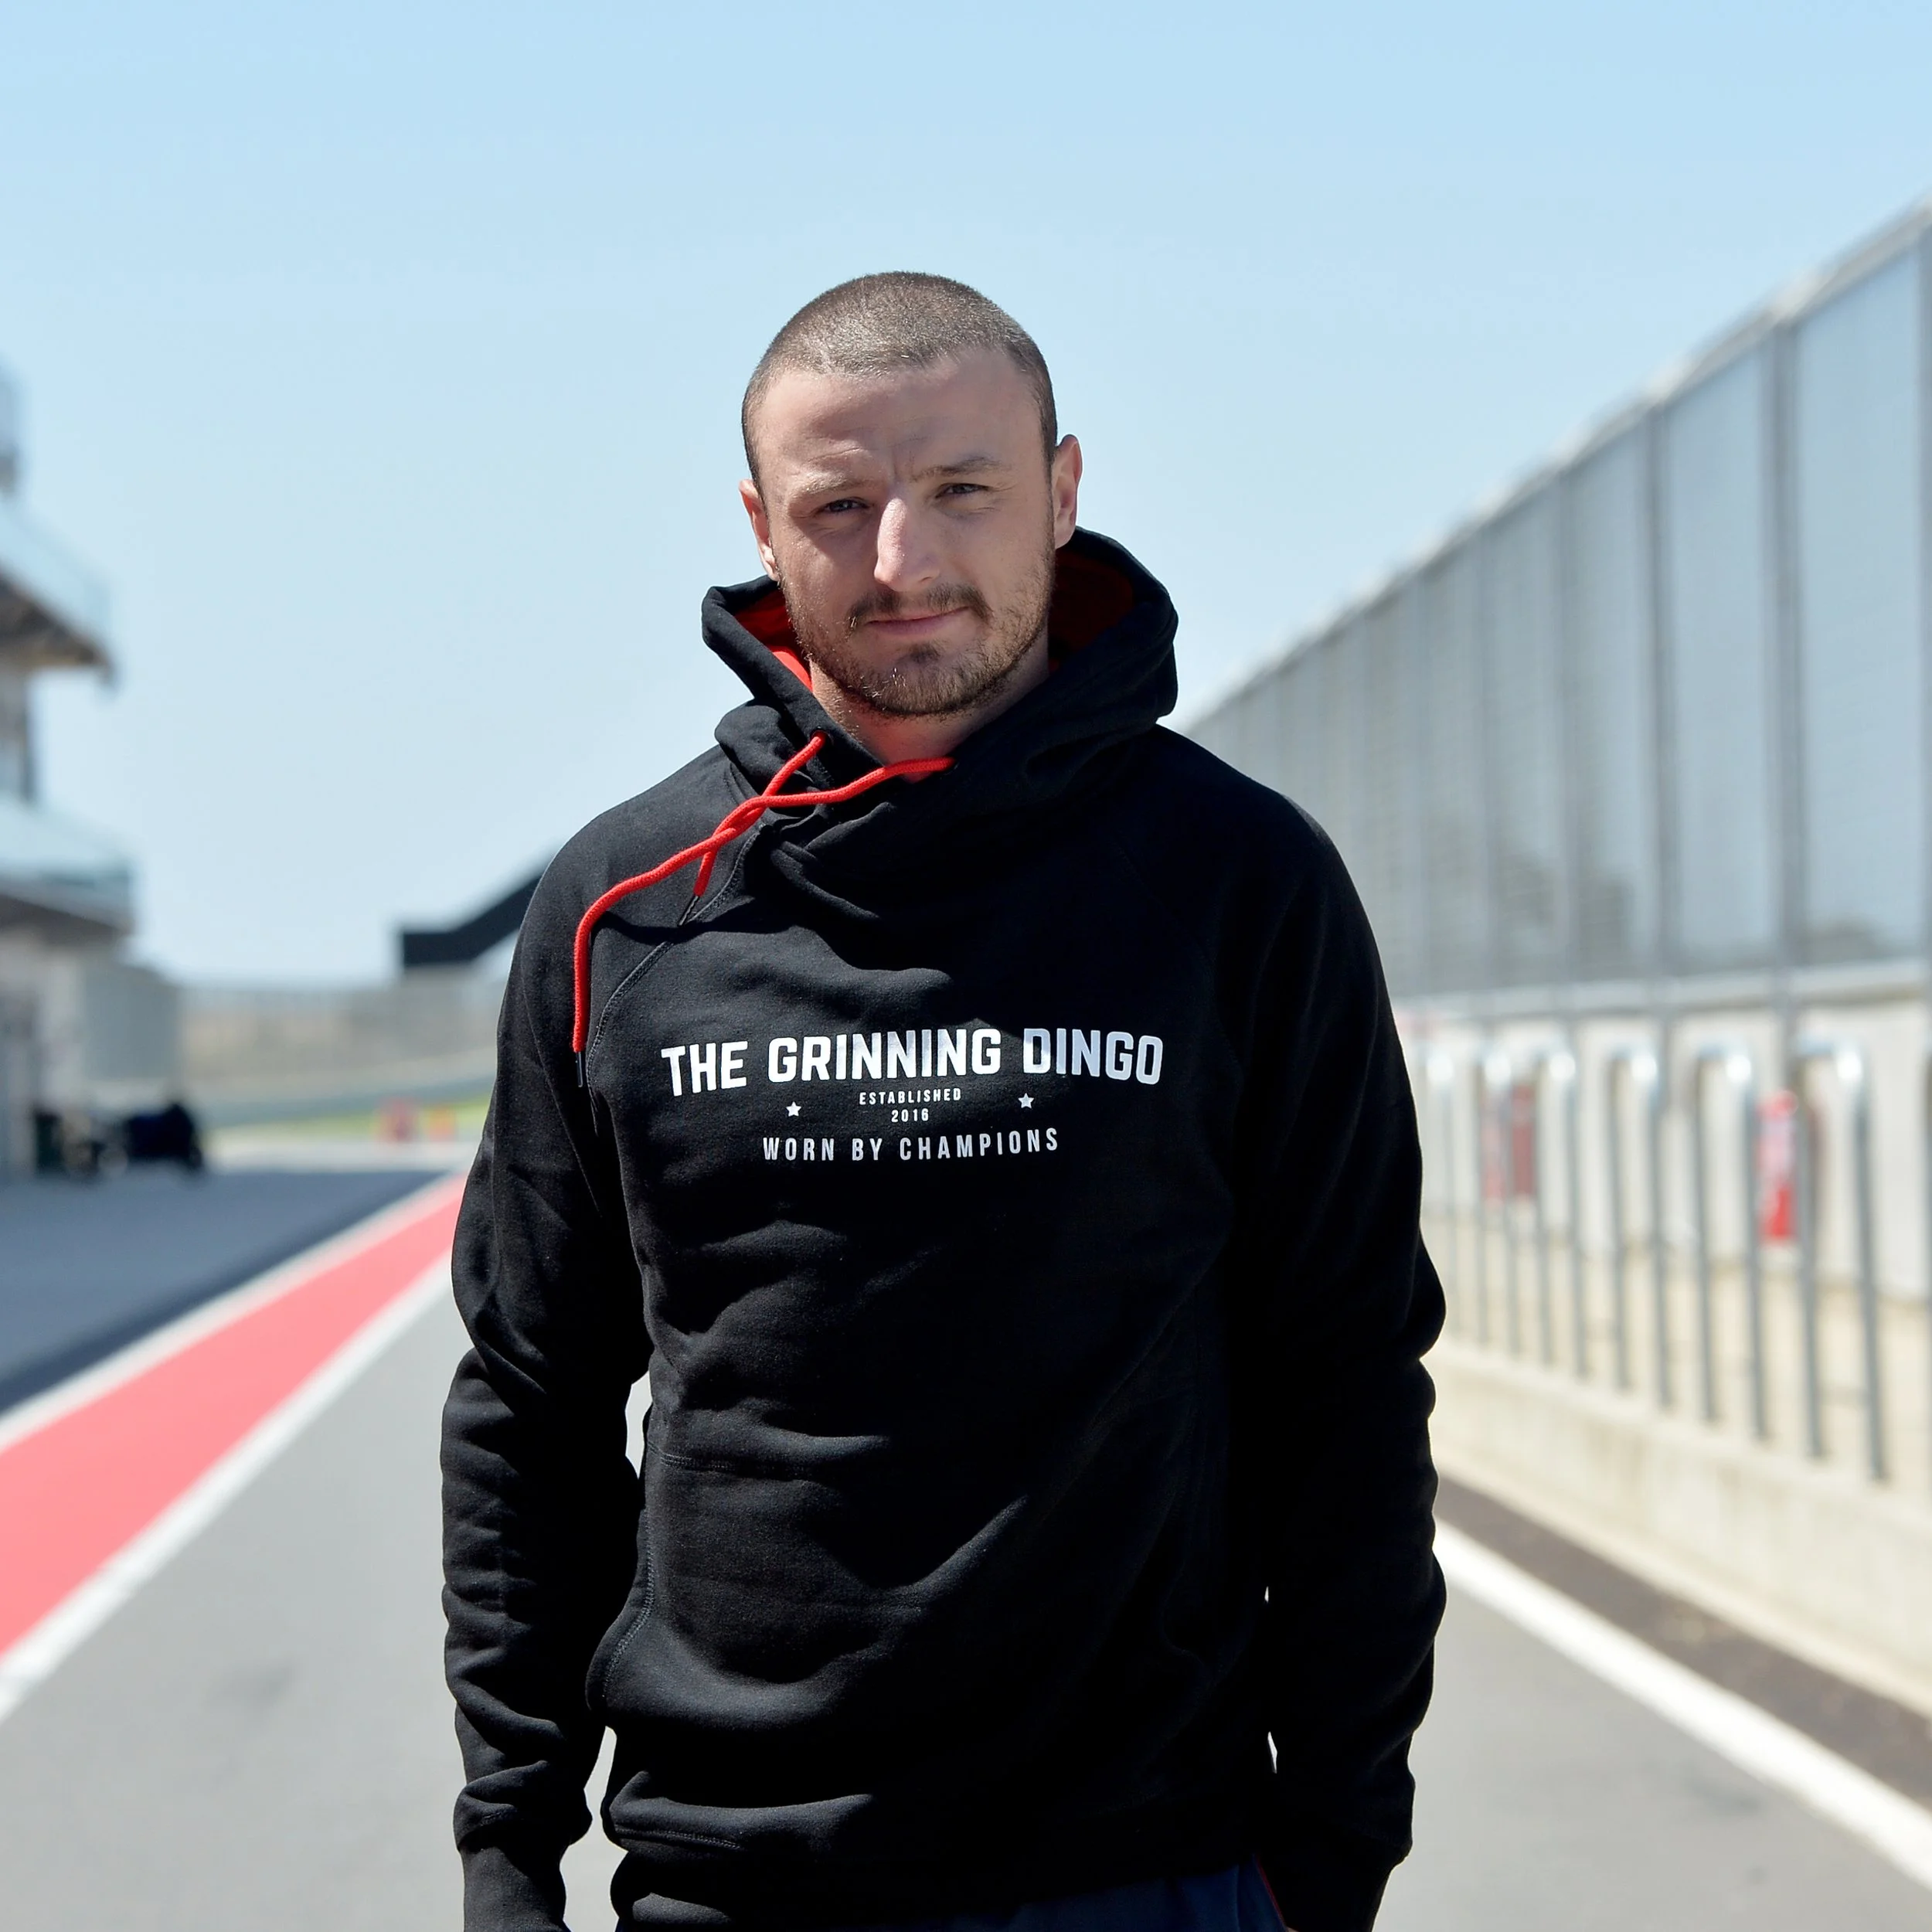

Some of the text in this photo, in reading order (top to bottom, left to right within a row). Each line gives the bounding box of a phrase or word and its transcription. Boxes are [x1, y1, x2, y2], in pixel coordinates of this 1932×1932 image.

[660, 1028, 1164, 1097] THE GRINNING DINGO
[859, 1087, 961, 1105] ESTABLISHED
[891, 1107, 929, 1123] 2016
[763, 1128, 1058, 1162] WORN BY CHAMPIONS
